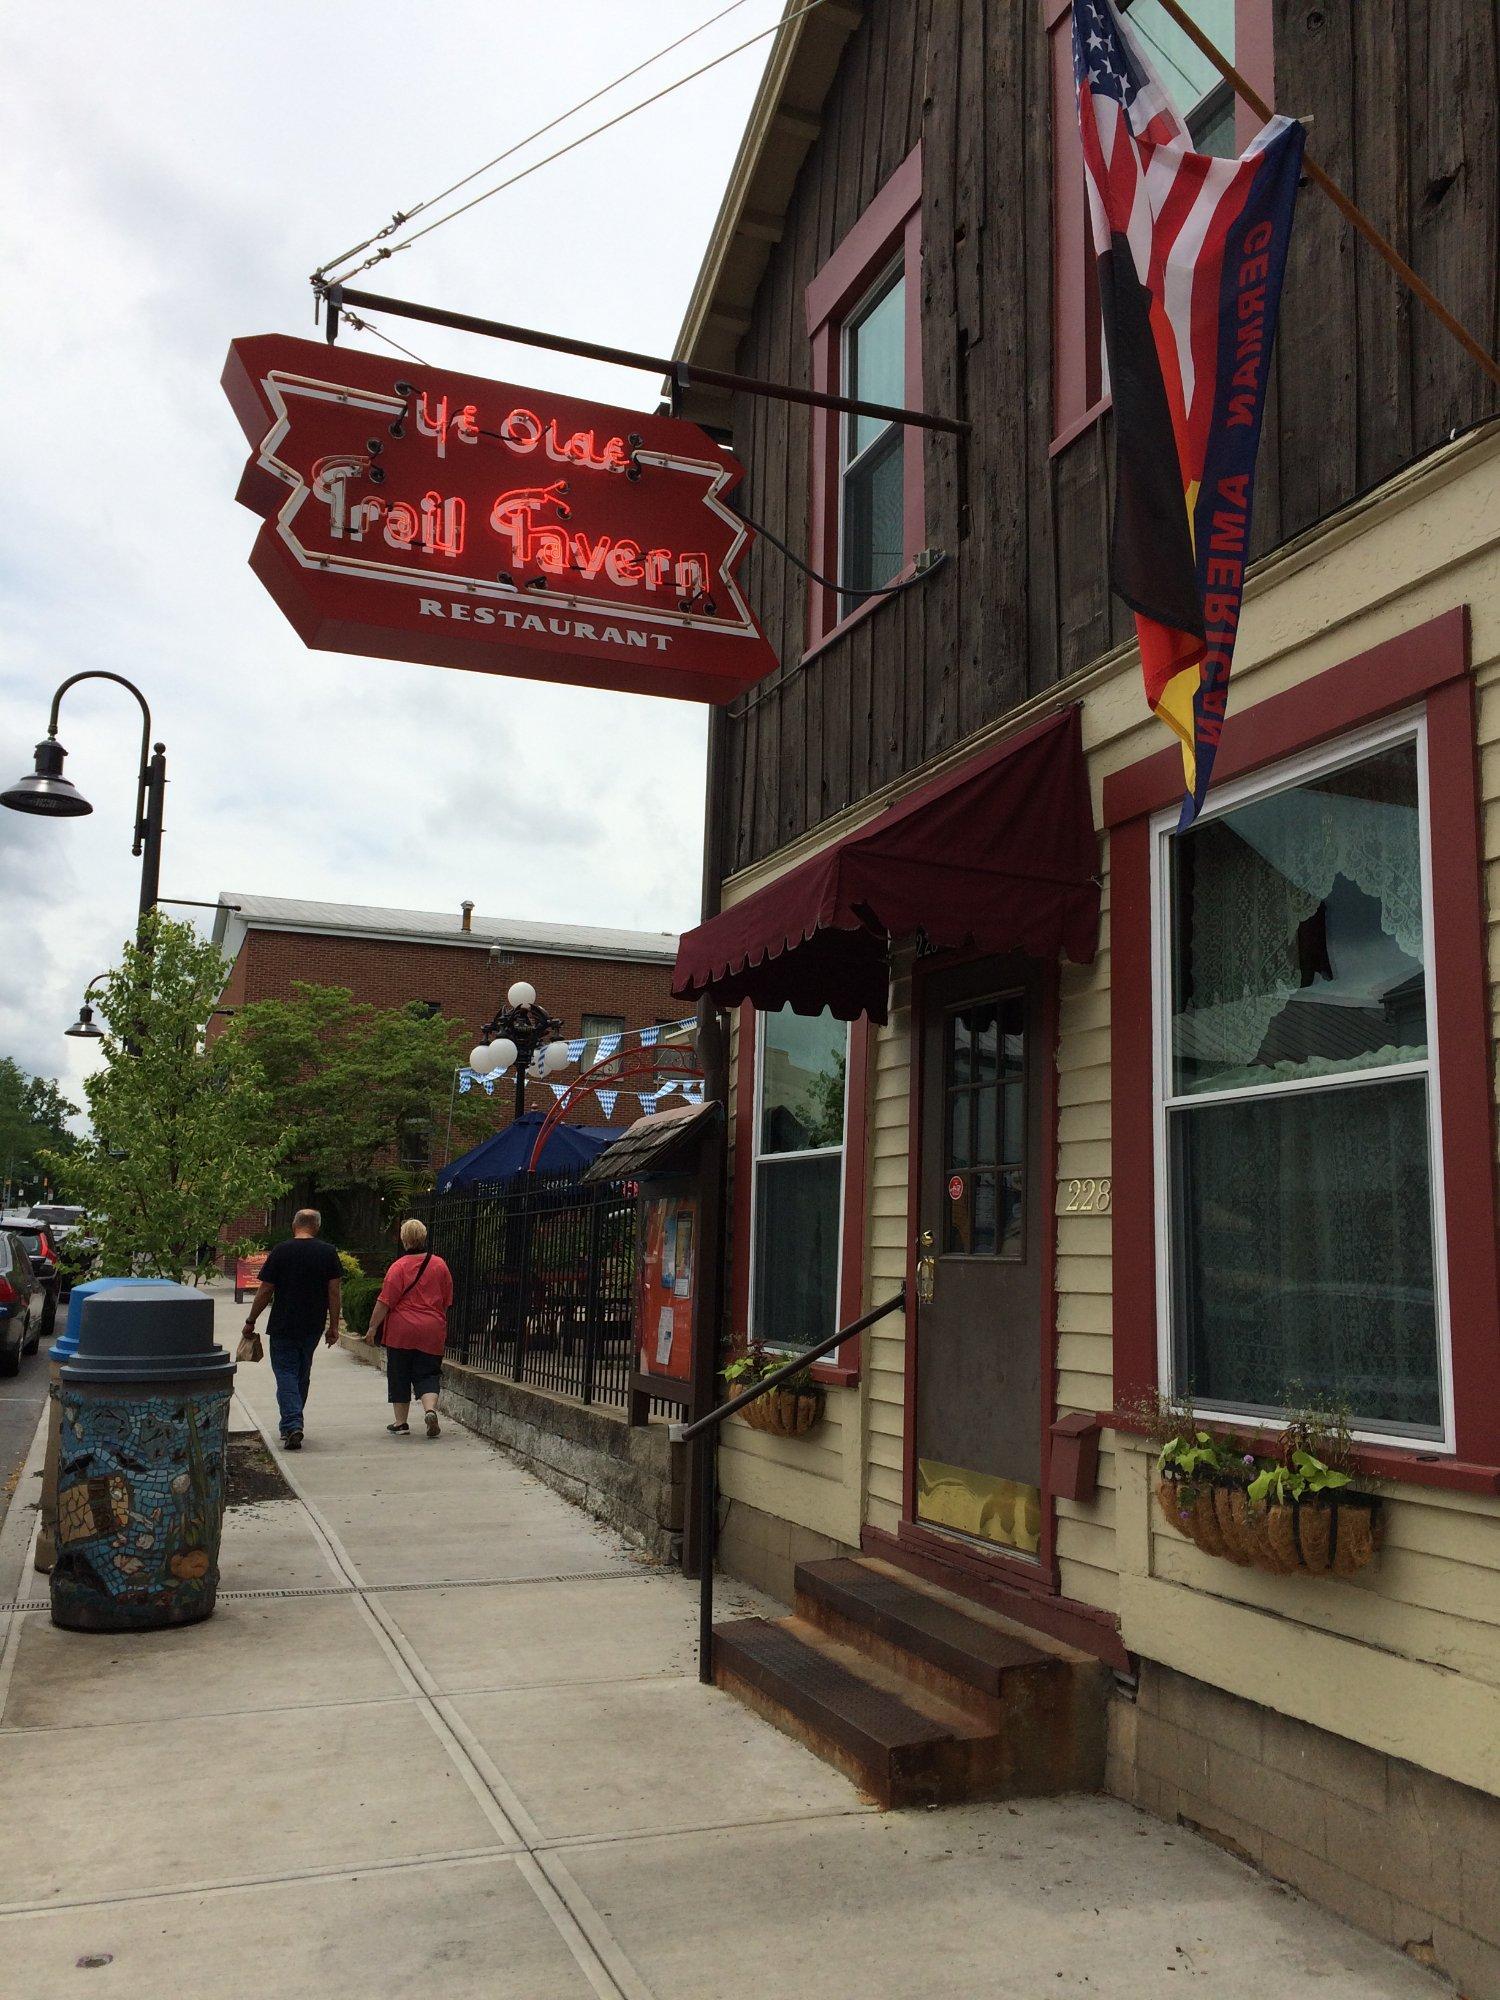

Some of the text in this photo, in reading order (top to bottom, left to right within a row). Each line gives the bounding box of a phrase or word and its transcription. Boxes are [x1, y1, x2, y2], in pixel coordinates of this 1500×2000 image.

[416, 391, 629, 473] Ye Olde
[311, 455, 710, 600] Trail Tavern
[419, 598, 673, 651] RESTAURANT
[1066, 1178, 1112, 1212] 228
